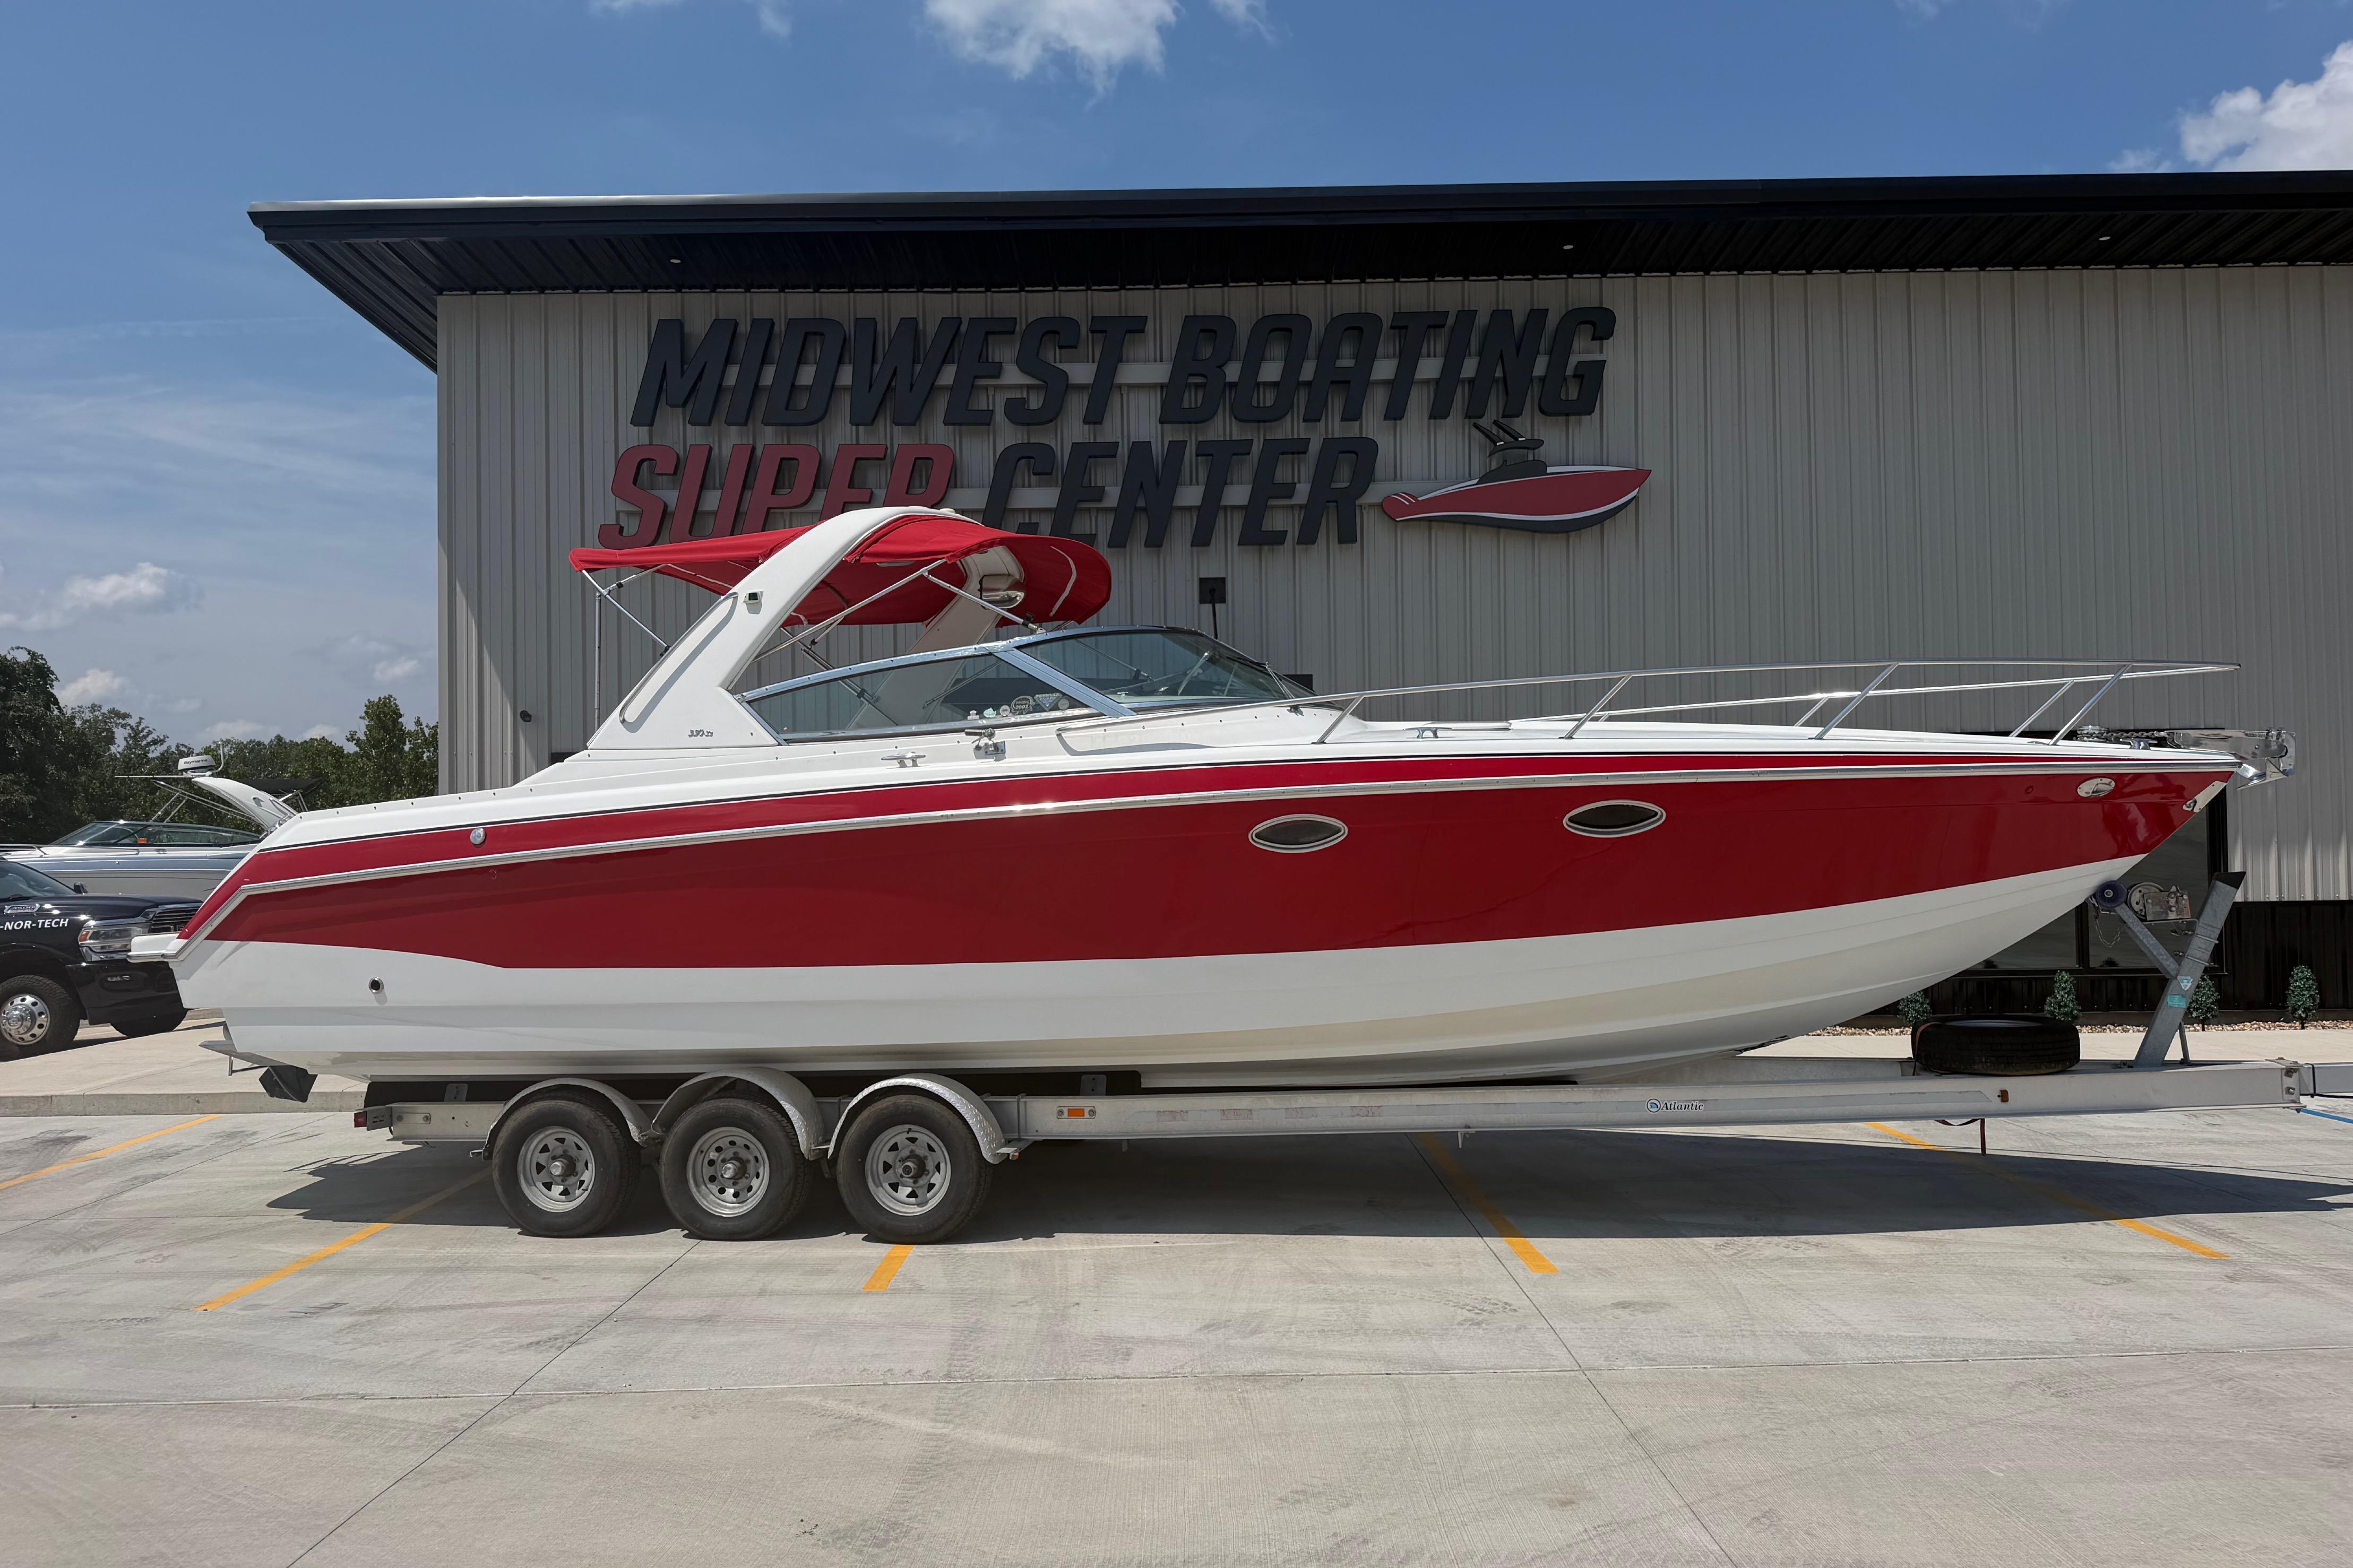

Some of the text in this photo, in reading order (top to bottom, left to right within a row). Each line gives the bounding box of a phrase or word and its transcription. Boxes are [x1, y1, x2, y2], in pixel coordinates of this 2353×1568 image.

[630, 307, 1616, 427] MIDWEST BOATING
[981, 437, 1379, 548] CENTER
[1661, 1102, 1703, 1111] Atlantic
